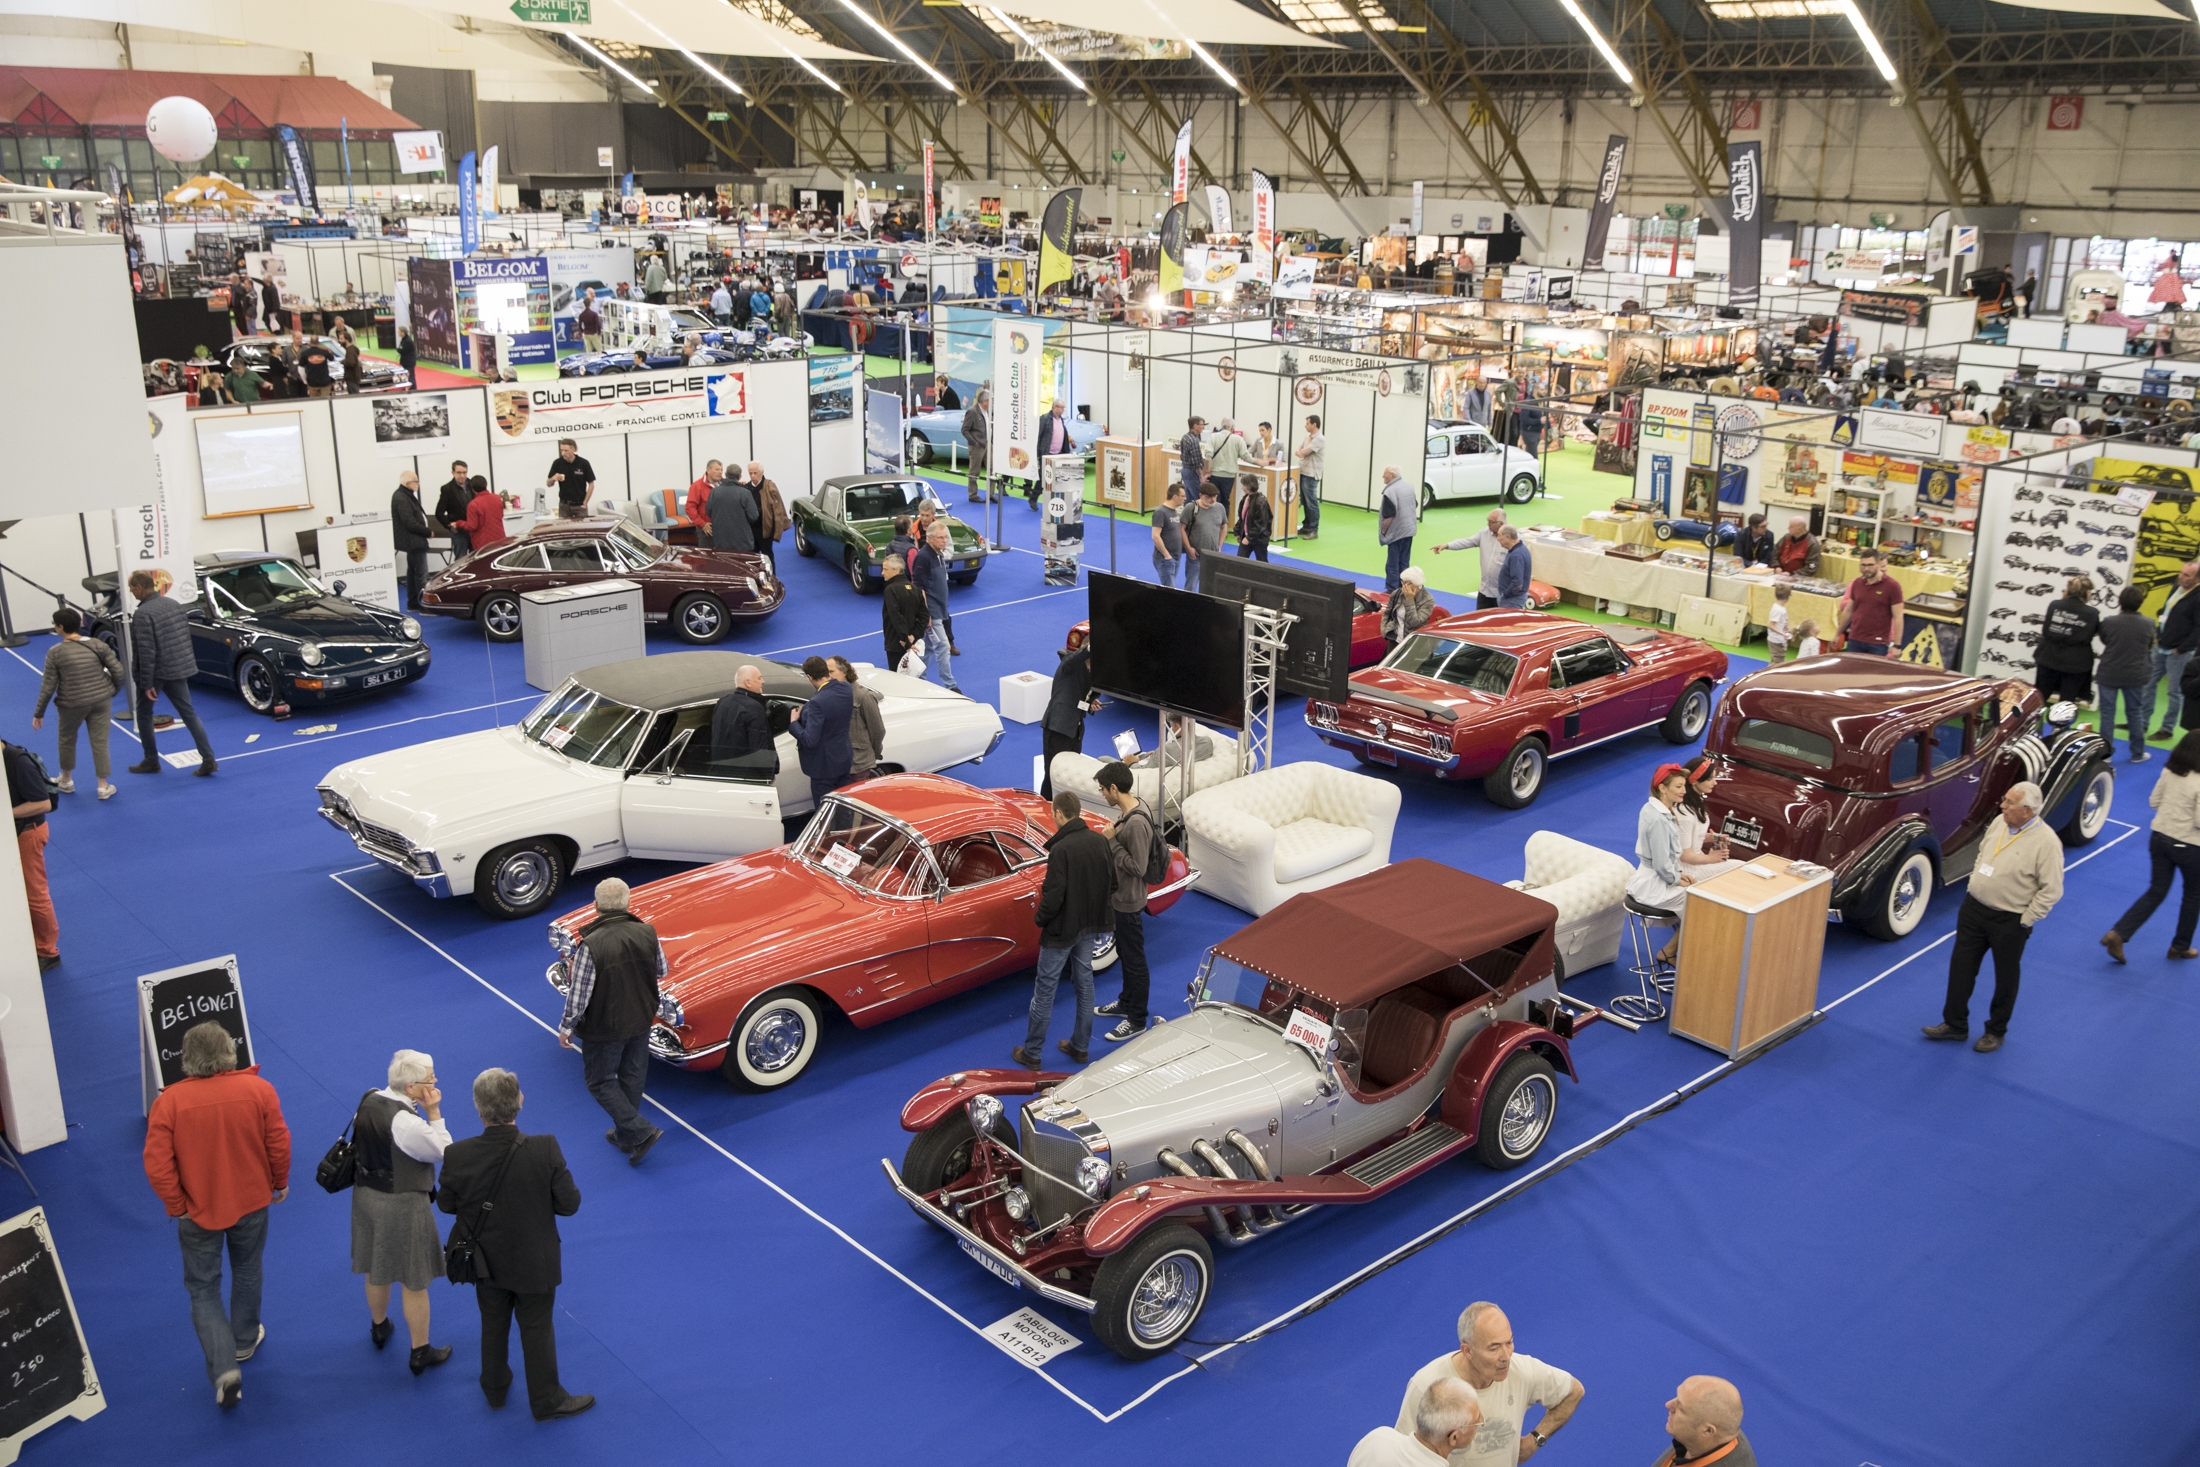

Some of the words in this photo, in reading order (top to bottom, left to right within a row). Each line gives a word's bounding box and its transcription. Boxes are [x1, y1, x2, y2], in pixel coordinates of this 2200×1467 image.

[520, 0, 569, 10] SORTIE
[531, 11, 559, 21] EXIT
[465, 171, 475, 244] BELGOM
[463, 261, 540, 278] BELGOM
[557, 263, 589, 271] BELGOM
[1309, 355, 1354, 367] ASSURANCES
[822, 366, 838, 375] 718
[1011, 361, 1019, 389] Club
[533, 389, 572, 405] Club
[579, 377, 704, 399] PORSCHE
[812, 380, 851, 394] Cayman
[1010, 392, 1019, 441] Porsche
[1660, 406, 1689, 418] ZOOM
[534, 422, 604, 434] BOURGOGNE
[616, 415, 667, 427] FRANCHE
[1050, 503, 1065, 513] 718
[140, 504, 155, 560] Porsch
[324, 562, 393, 578] PORSCHE
[560, 603, 628, 620] PORSCHE
[367, 674, 381, 686] 964
[394, 668, 402, 679] 21
[1301, 1005, 1314, 1017] FOR
[1312, 1009, 1329, 1023] SALE
[1289, 1023, 1303, 1038] 65
[1301, 1029, 1318, 1047] 000
[1012, 1321, 1054, 1349] MOTORS
[1019, 1312, 1070, 1346] FABULOUS
